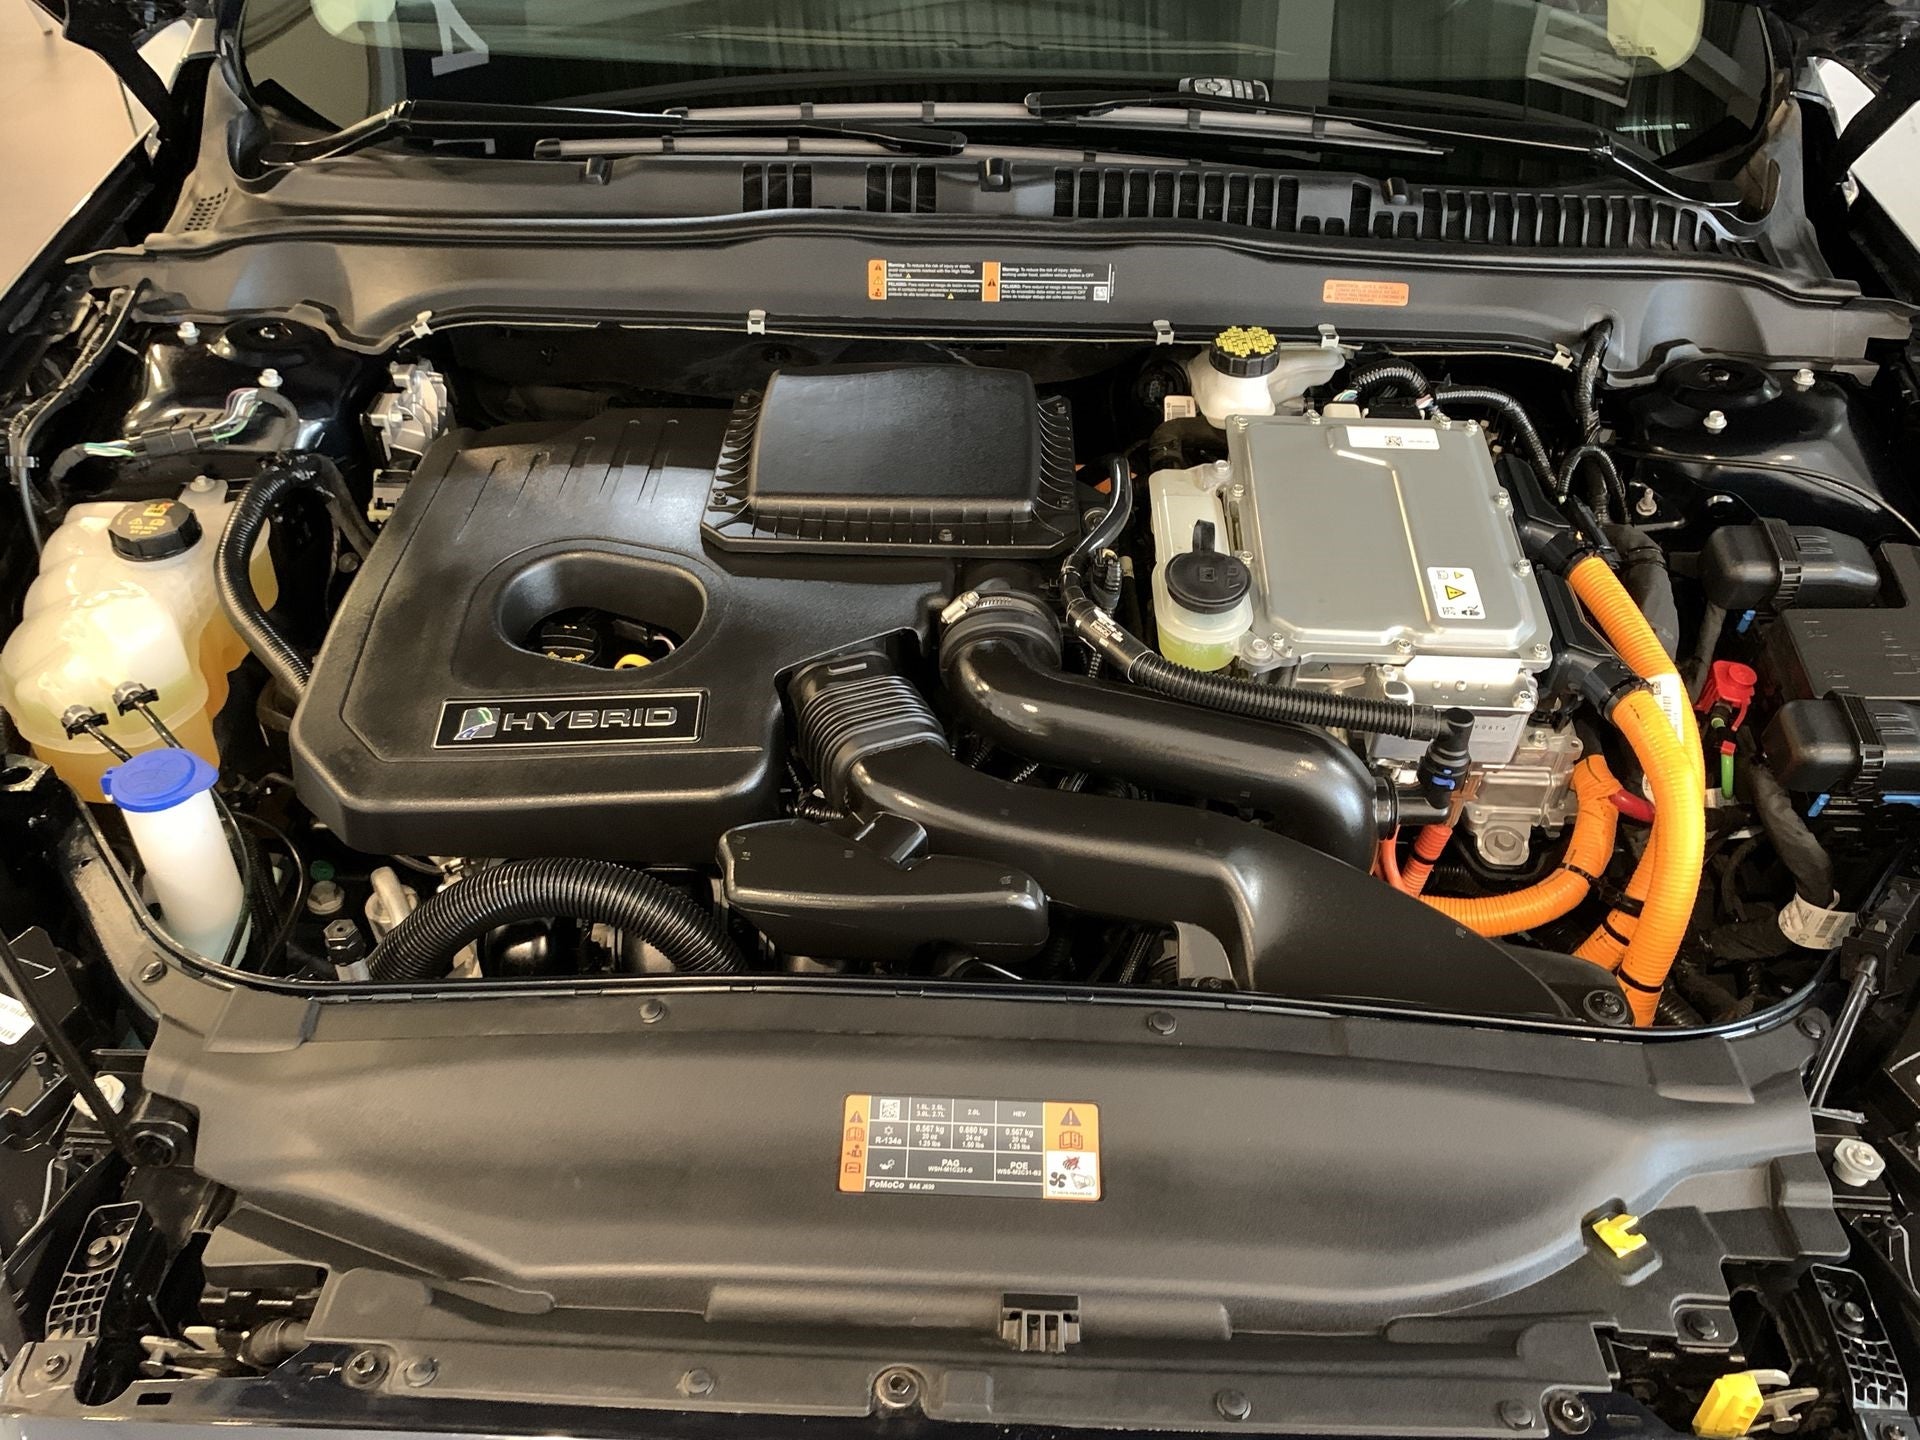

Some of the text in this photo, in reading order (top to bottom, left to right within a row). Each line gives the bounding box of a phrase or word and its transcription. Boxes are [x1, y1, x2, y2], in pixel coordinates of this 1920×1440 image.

[502, 706, 678, 731] HYBRID
[935, 1126, 945, 1135] kg
[979, 1127, 988, 1136] kg
[1025, 1129, 1034, 1138] kg
[874, 1136, 902, 1145] R-134a
[869, 1180, 904, 1189] FoMoCo
